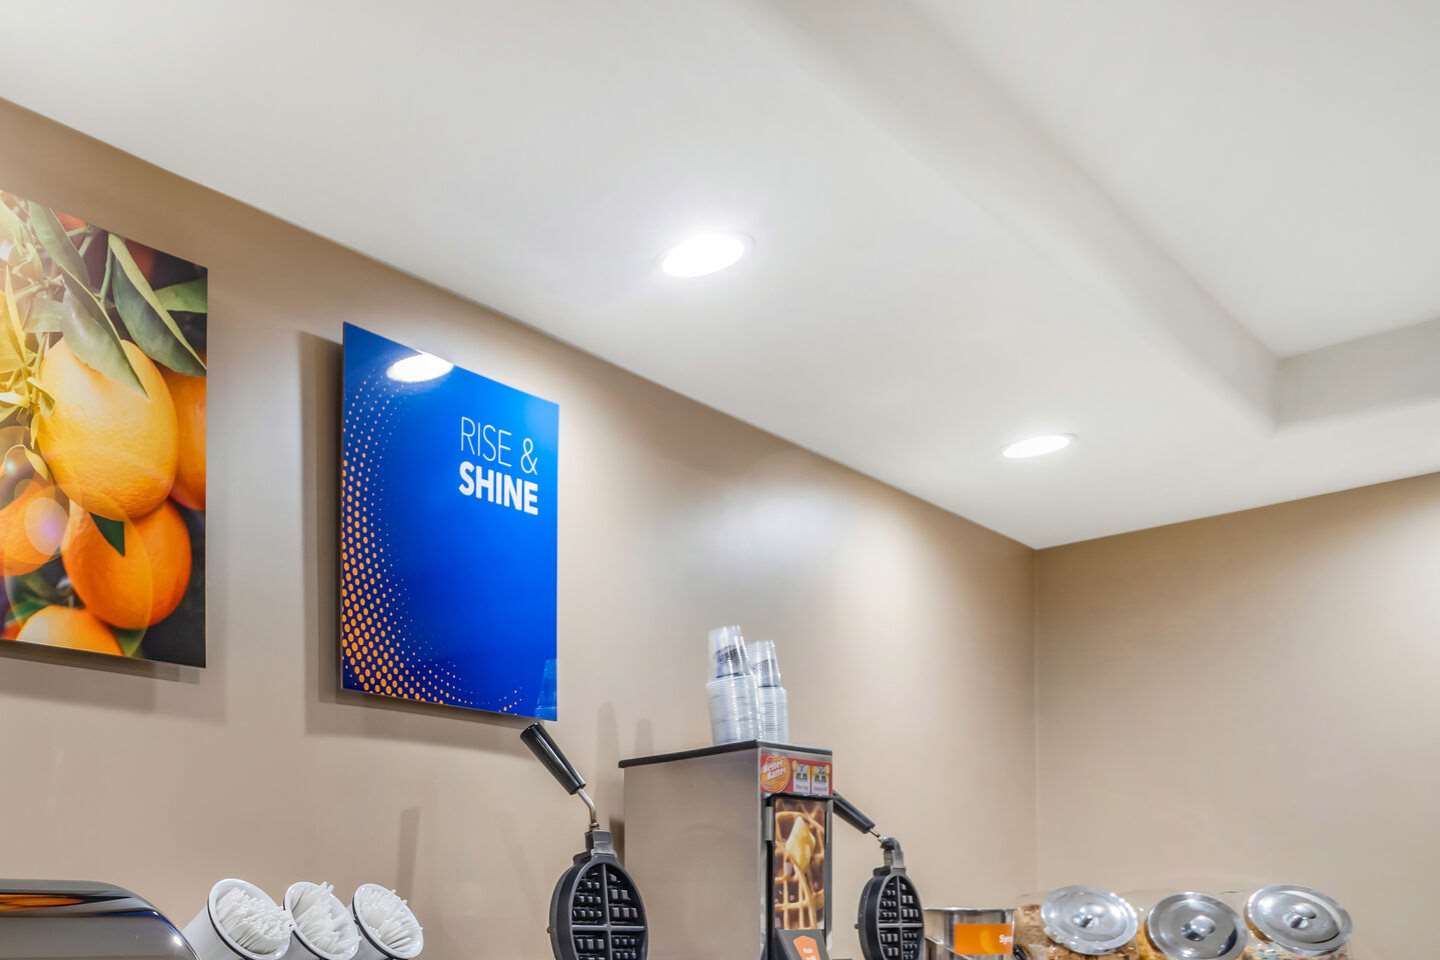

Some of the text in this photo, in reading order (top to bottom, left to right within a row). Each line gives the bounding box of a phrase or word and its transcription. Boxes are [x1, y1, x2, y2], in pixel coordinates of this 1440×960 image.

[460, 415, 538, 475] RISE &
[459, 460, 538, 516] SHINE
